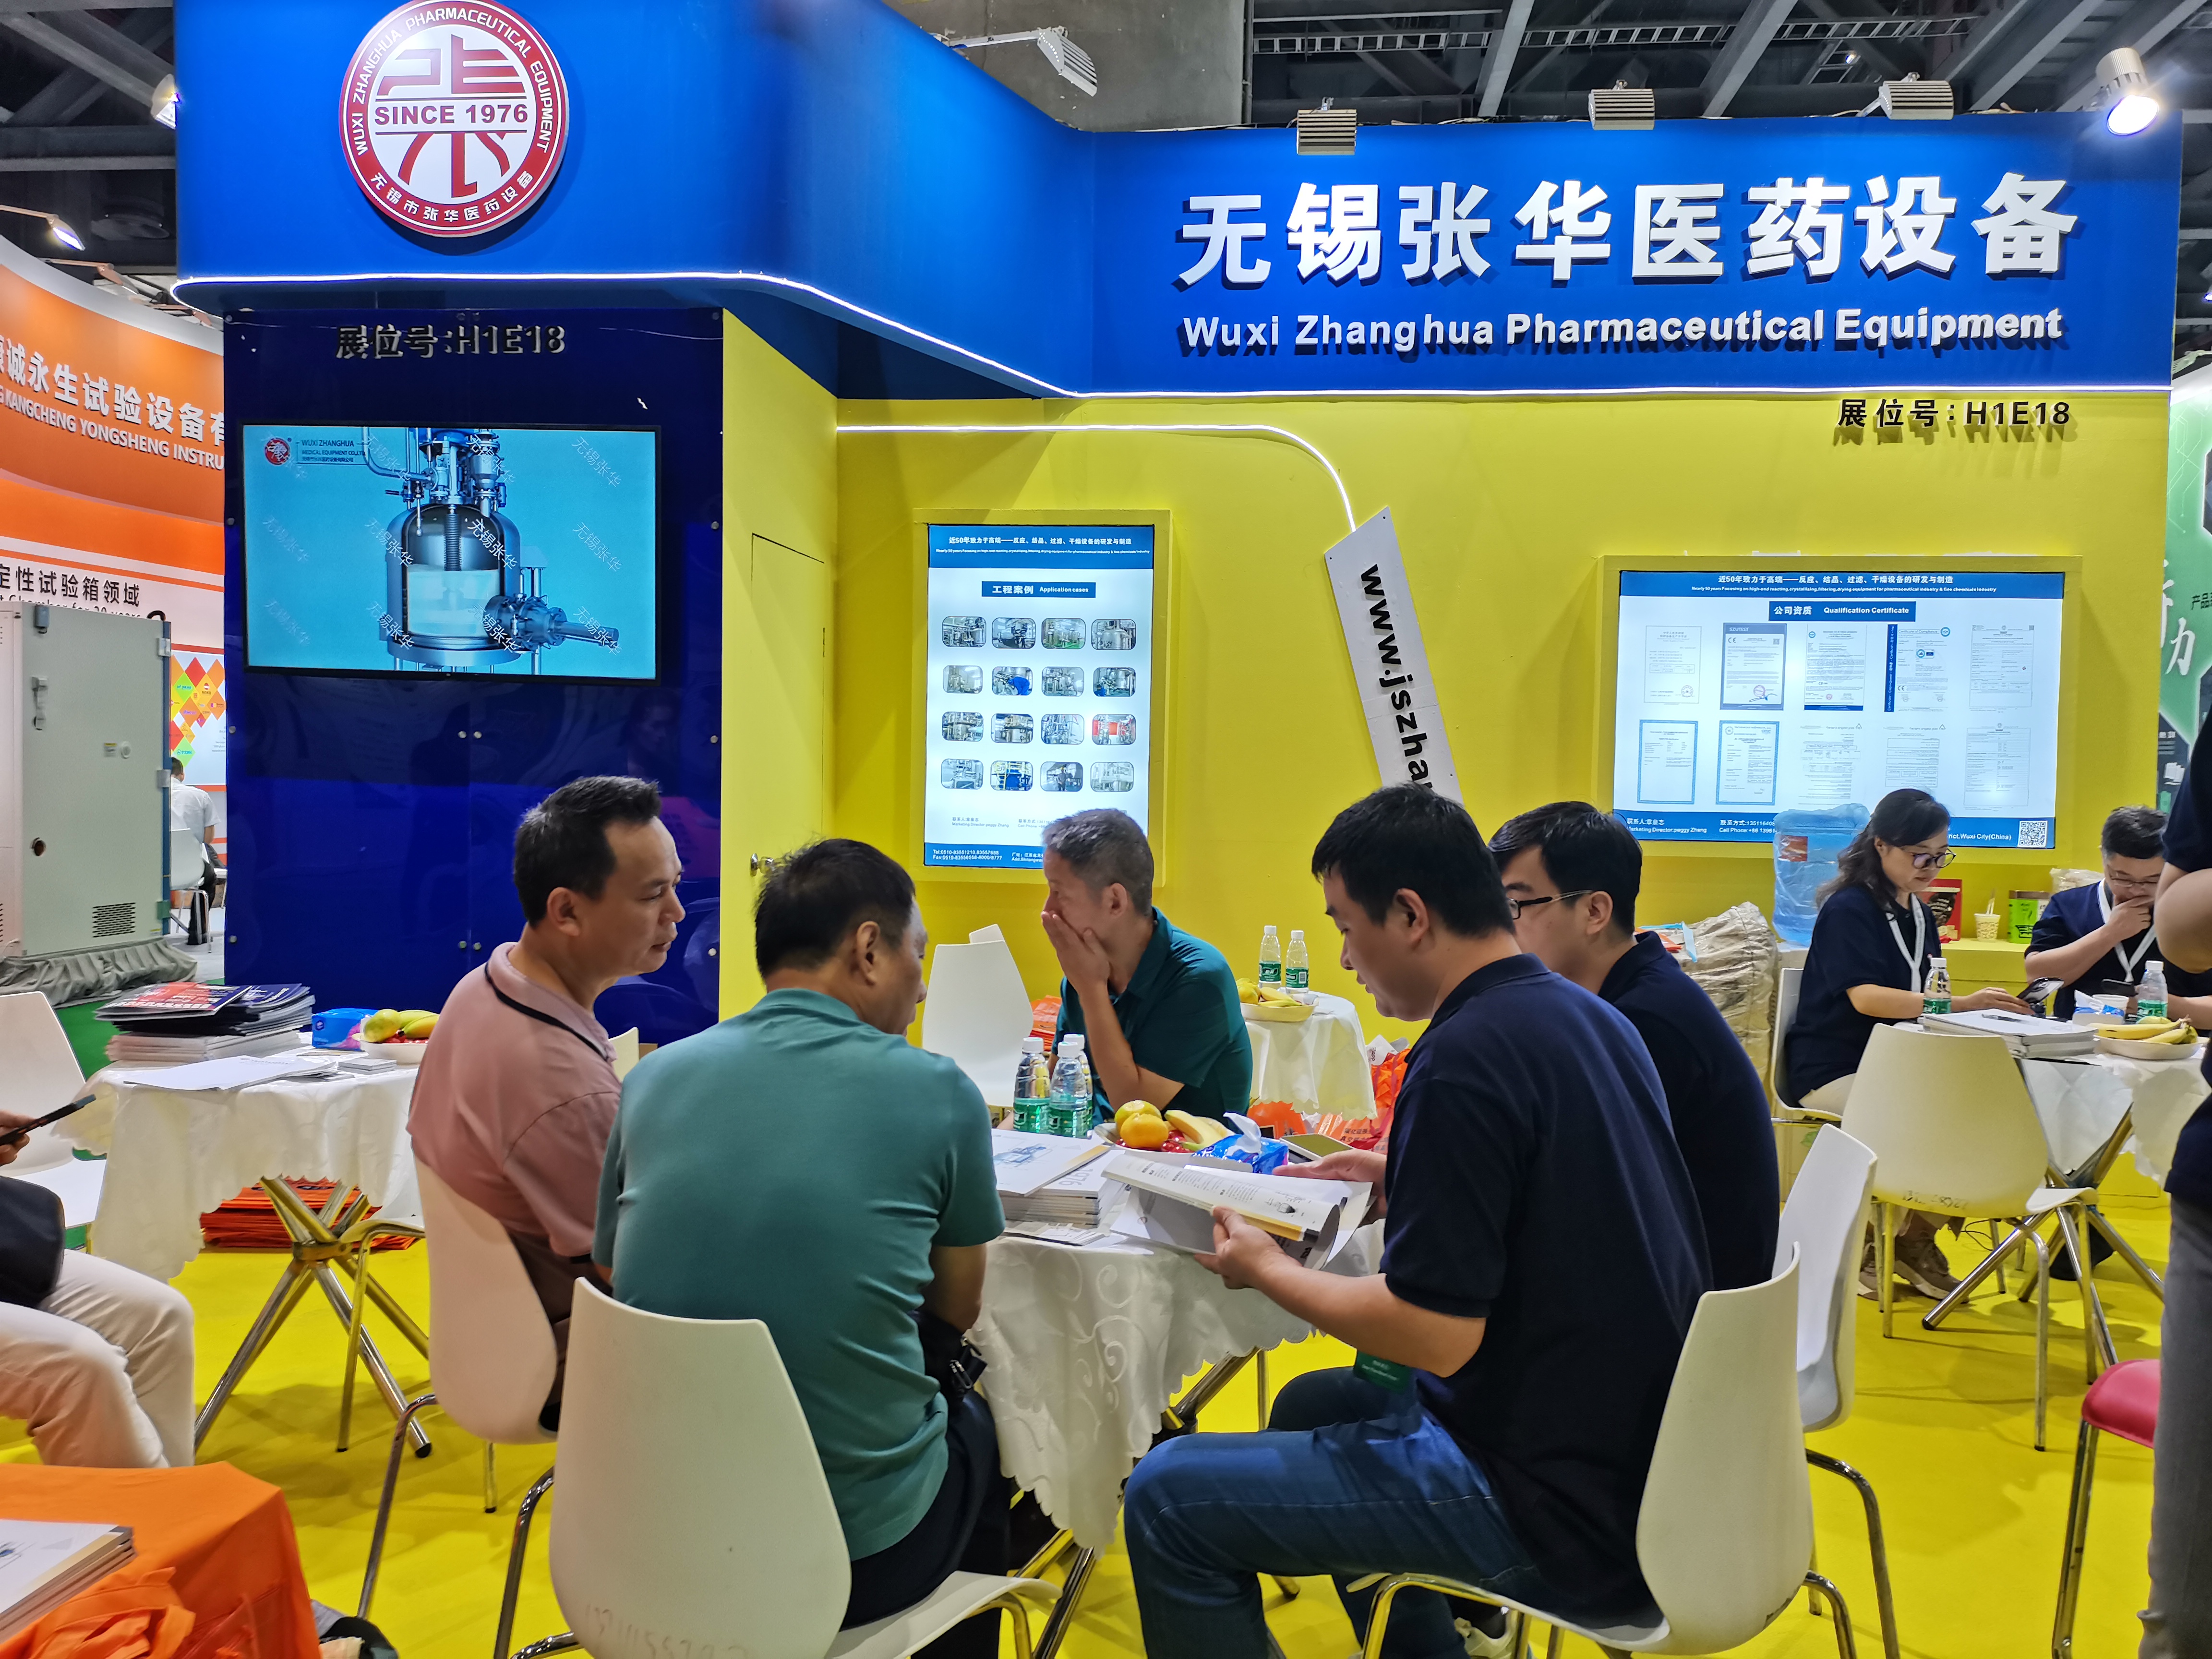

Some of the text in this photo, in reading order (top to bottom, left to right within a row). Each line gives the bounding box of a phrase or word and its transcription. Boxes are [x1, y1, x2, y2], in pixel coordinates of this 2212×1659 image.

[351, 7, 554, 156] WUXI ZHANGHUA PHARMACEUTICAL EQUIPMENT
[374, 104, 528, 125] SINCE 1976
[371, 170, 533, 223] 无锡市张华医药设备
[1178, 172, 2079, 286] 无锡张华医药设备
[1183, 307, 2063, 352] Wuxi Zhanghua Pharmaceutical Equipment
[0, 335, 224, 446] 诚永生试验设备有
[6, 391, 76, 433] KANGCHENG
[80, 418, 169, 457] YONGSHENG
[571, 436, 622, 487] 无锡张华
[364, 518, 414, 567] 无锡张华
[467, 518, 518, 570] 无锡张华
[572, 522, 624, 572] 无锡张华
[992, 585, 1034, 594] 工程案例
[1774, 605, 1812, 615] 公司资质
[2191, 592, 2212, 610] 产品
[366, 601, 415, 650] 无锡张华
[573, 606, 623, 656] 无锡张华
[1361, 564, 1434, 791] www.jszha
